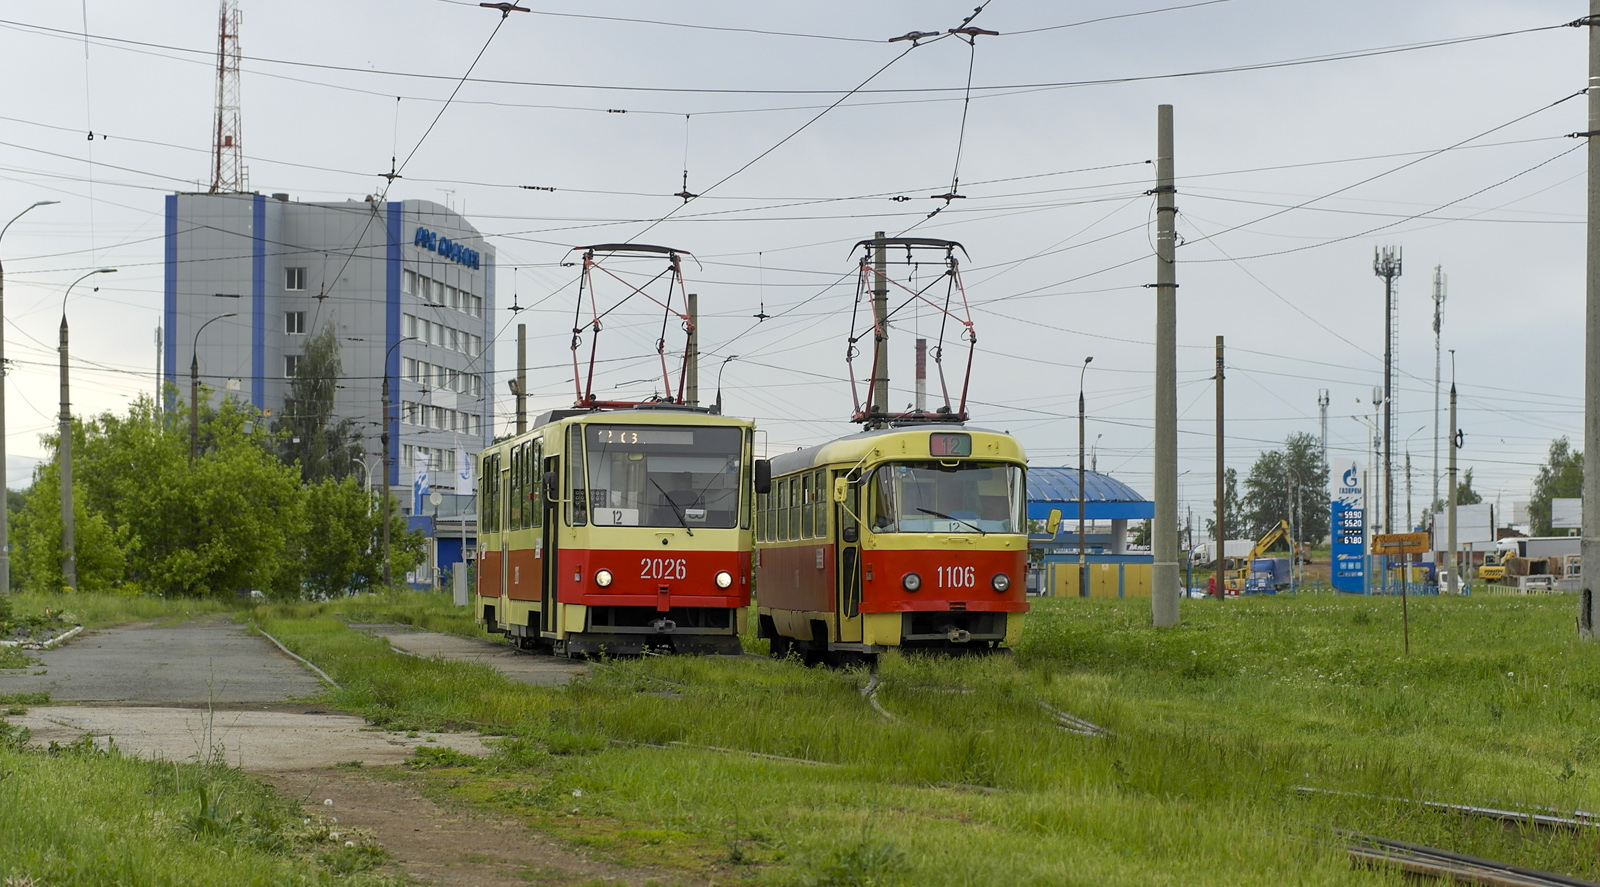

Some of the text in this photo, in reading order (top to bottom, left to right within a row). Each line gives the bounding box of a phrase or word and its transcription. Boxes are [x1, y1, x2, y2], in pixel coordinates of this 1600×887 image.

[942, 435, 960, 455] 12
[612, 510, 623, 525] 12
[640, 558, 687, 580] 2026
[937, 566, 975, 588] 1106
